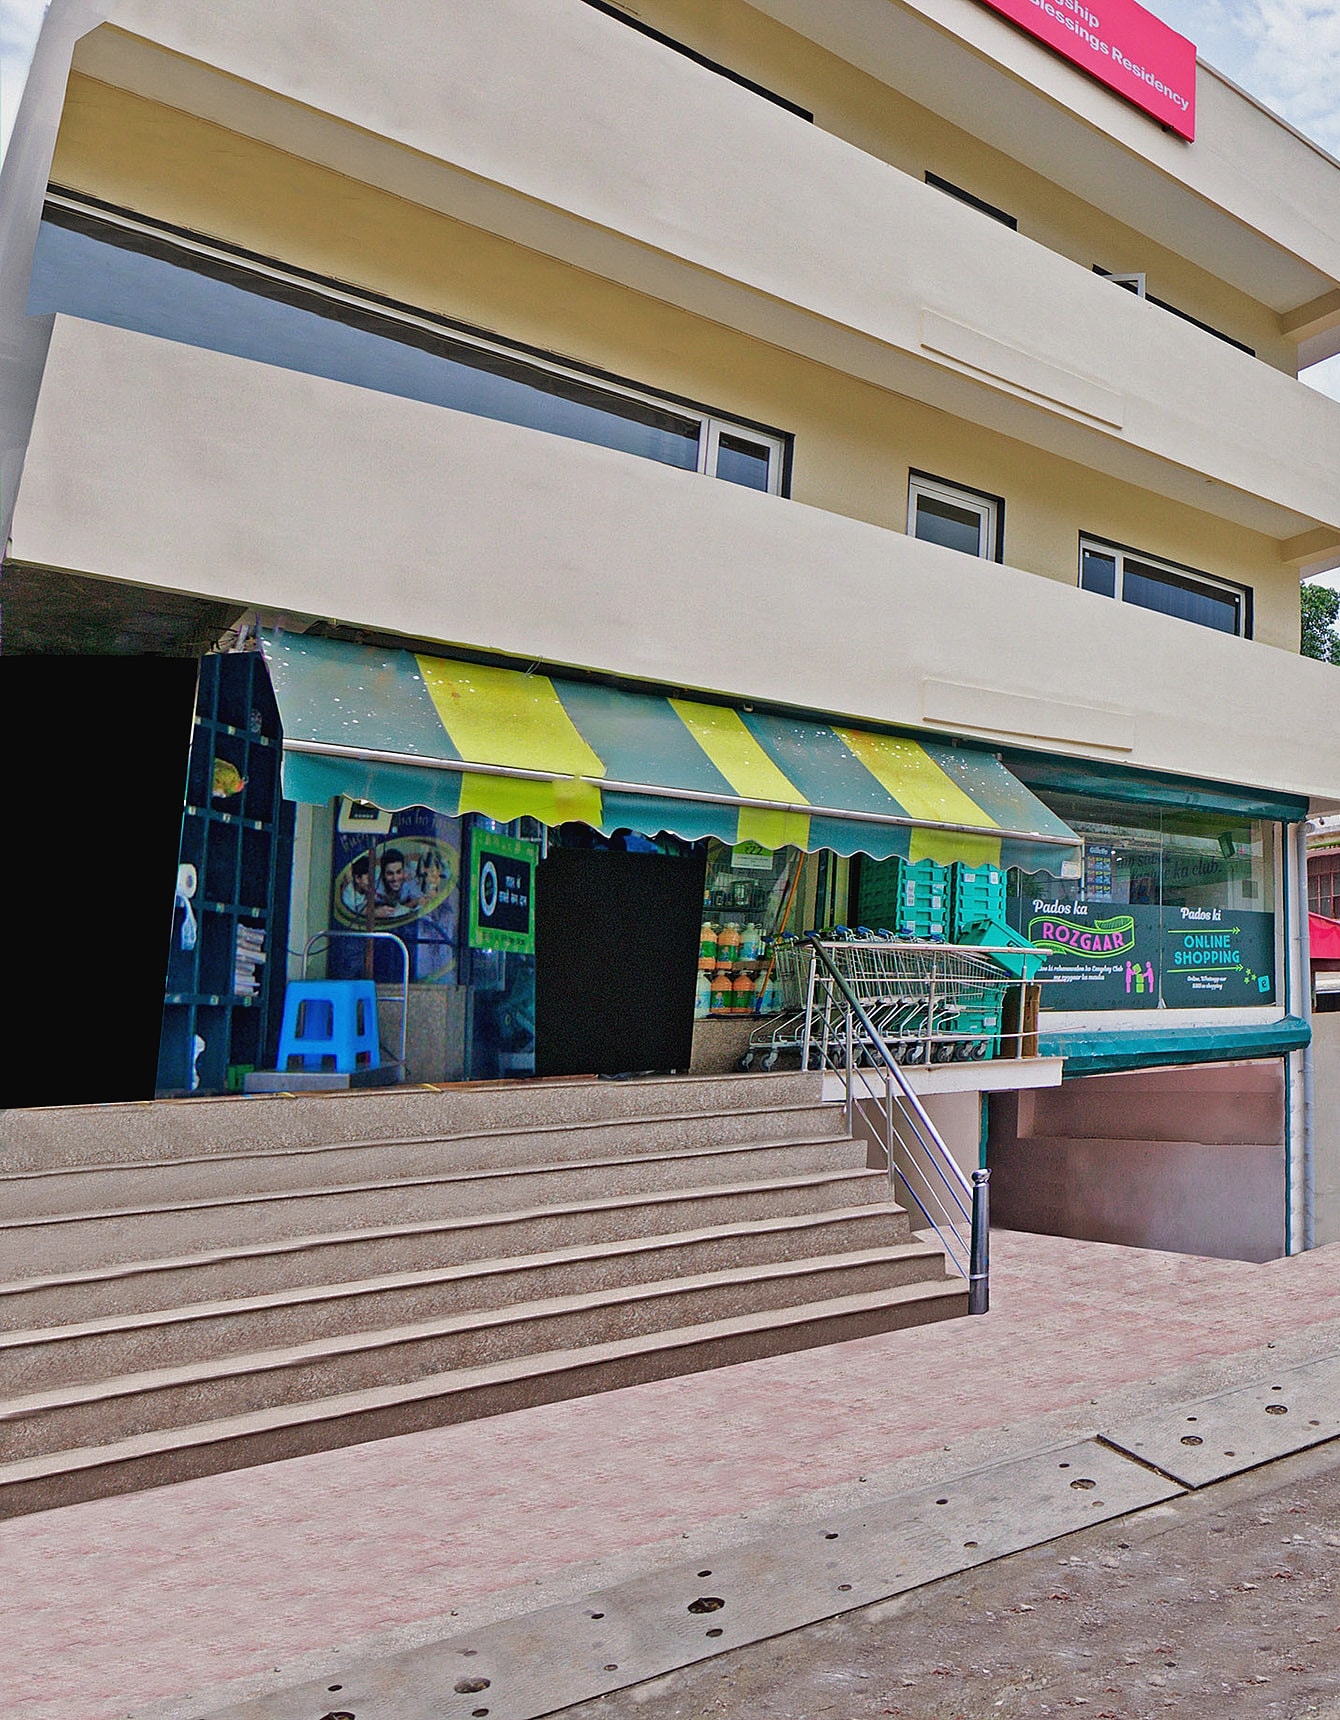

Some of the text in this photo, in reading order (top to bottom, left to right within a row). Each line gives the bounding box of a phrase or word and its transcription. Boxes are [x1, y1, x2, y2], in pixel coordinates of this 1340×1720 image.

[1111, 46, 1190, 111] Residency
[1033, 899, 1088, 915] Pados ka
[1180, 907, 1222, 921] Pados ki
[1042, 922, 1124, 951] ROZGAAR
[1184, 935, 1231, 949] ONLINE
[1174, 950, 1240, 965] SHOPPING
